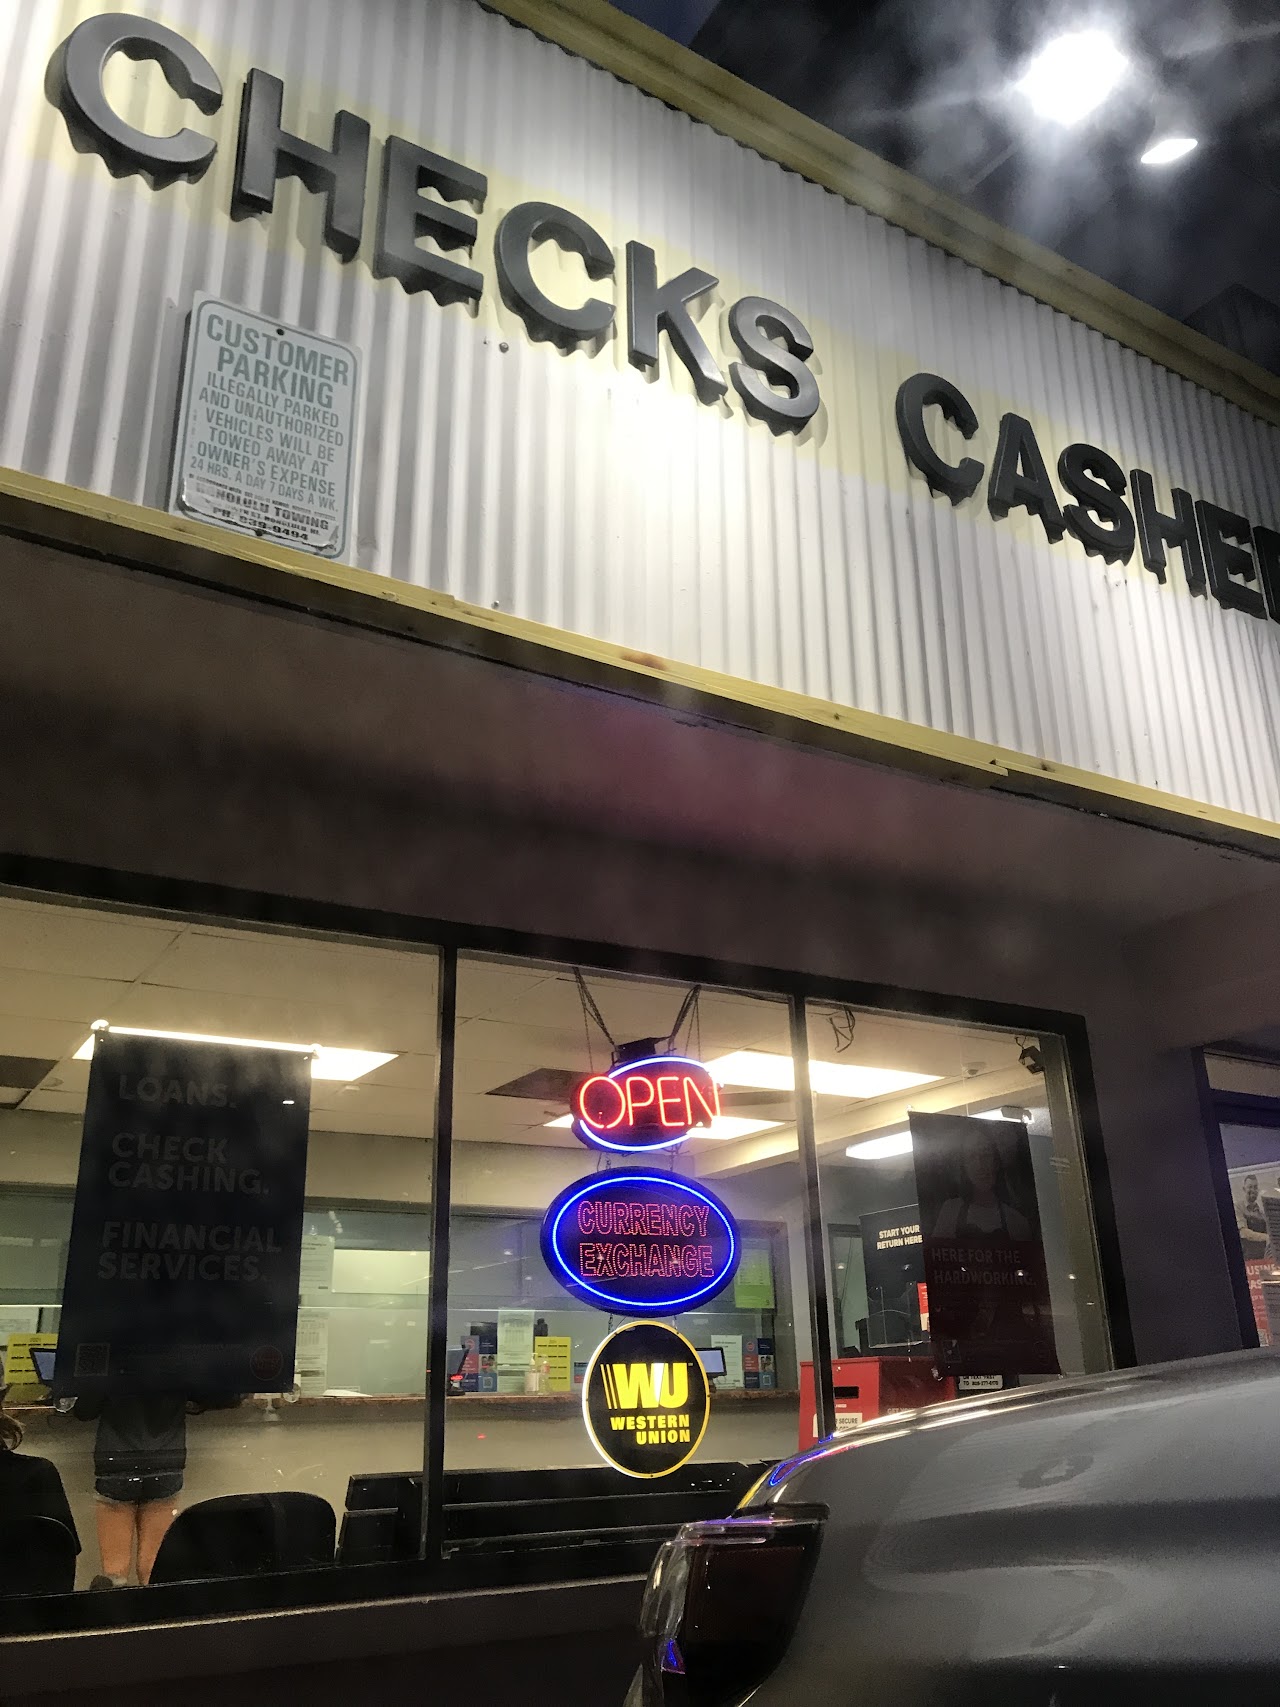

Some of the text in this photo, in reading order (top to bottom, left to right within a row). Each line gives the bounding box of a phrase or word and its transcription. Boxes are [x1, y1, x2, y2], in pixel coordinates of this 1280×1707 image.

[45, 13, 819, 436] CHECKS
[207, 314, 349, 386] CUSTOMER
[217, 346, 333, 408] PARKING
[199, 387, 344, 446] AND UNAUTHORIZED
[207, 371, 339, 428] ILLEGALLY PARKED
[206, 407, 335, 462] VEHICLES WILL BE
[209, 426, 328, 477] TOWED AWAY AT
[190, 456, 204, 471] 24
[207, 462, 232, 480] HRS.
[235, 471, 242, 483] A
[245, 474, 266, 490] DAY
[270, 481, 275, 493] 7
[278, 485, 304, 503] DAYS
[307, 493, 315, 505] A
[318, 495, 338, 512] WK.
[197, 441, 335, 497] OWNER'S EXPENSE
[274, 506, 329, 530] TOWING
[579, 1074, 721, 1129] OPEN
[111, 1132, 230, 1164] CHECK
[108, 1161, 271, 1196] CASHING.
[102, 1220, 282, 1253] FINANCIAL
[577, 1200, 711, 1237] CURRENCY
[878, 1224, 921, 1239] START YOUR
[578, 1243, 715, 1278] EXCHANGE
[876, 1235, 924, 1250] RETURN HERE
[932, 1247, 1021, 1264] HERE FOR THE
[612, 1362, 689, 1409] WU
[610, 1414, 690, 1431] WESTERN
[636, 1429, 691, 1445] UNION
[838, 1417, 858, 1425] SECURE
